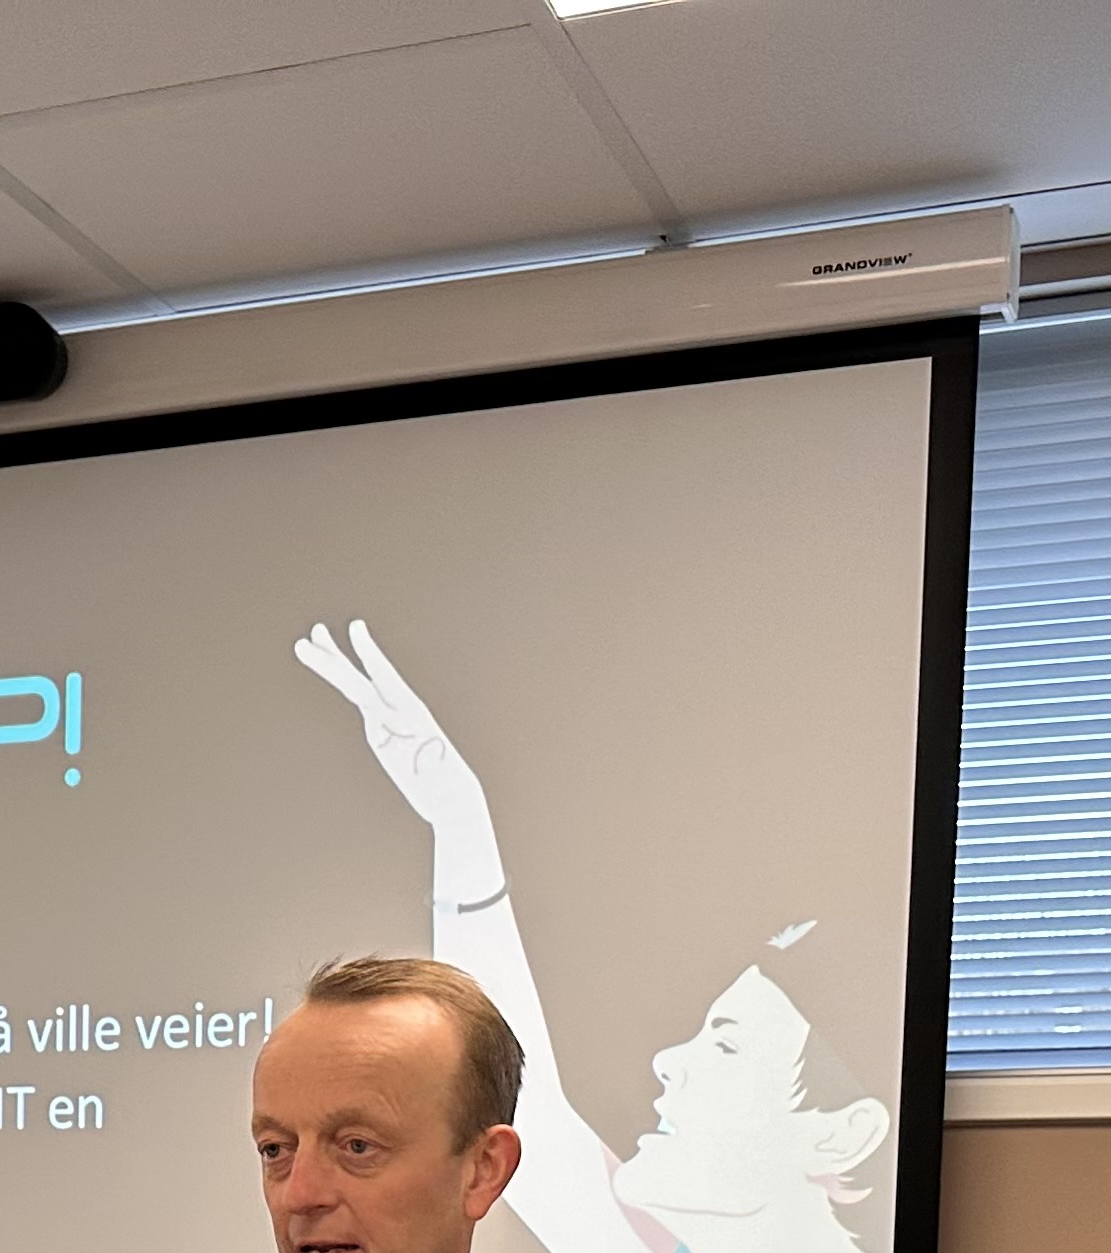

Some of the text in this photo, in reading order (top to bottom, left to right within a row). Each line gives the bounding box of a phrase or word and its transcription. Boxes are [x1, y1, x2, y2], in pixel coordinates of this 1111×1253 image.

[27, 1003, 121, 1053] ville
[135, 997, 274, 1050] veier!
[48, 1094, 103, 1130] en
